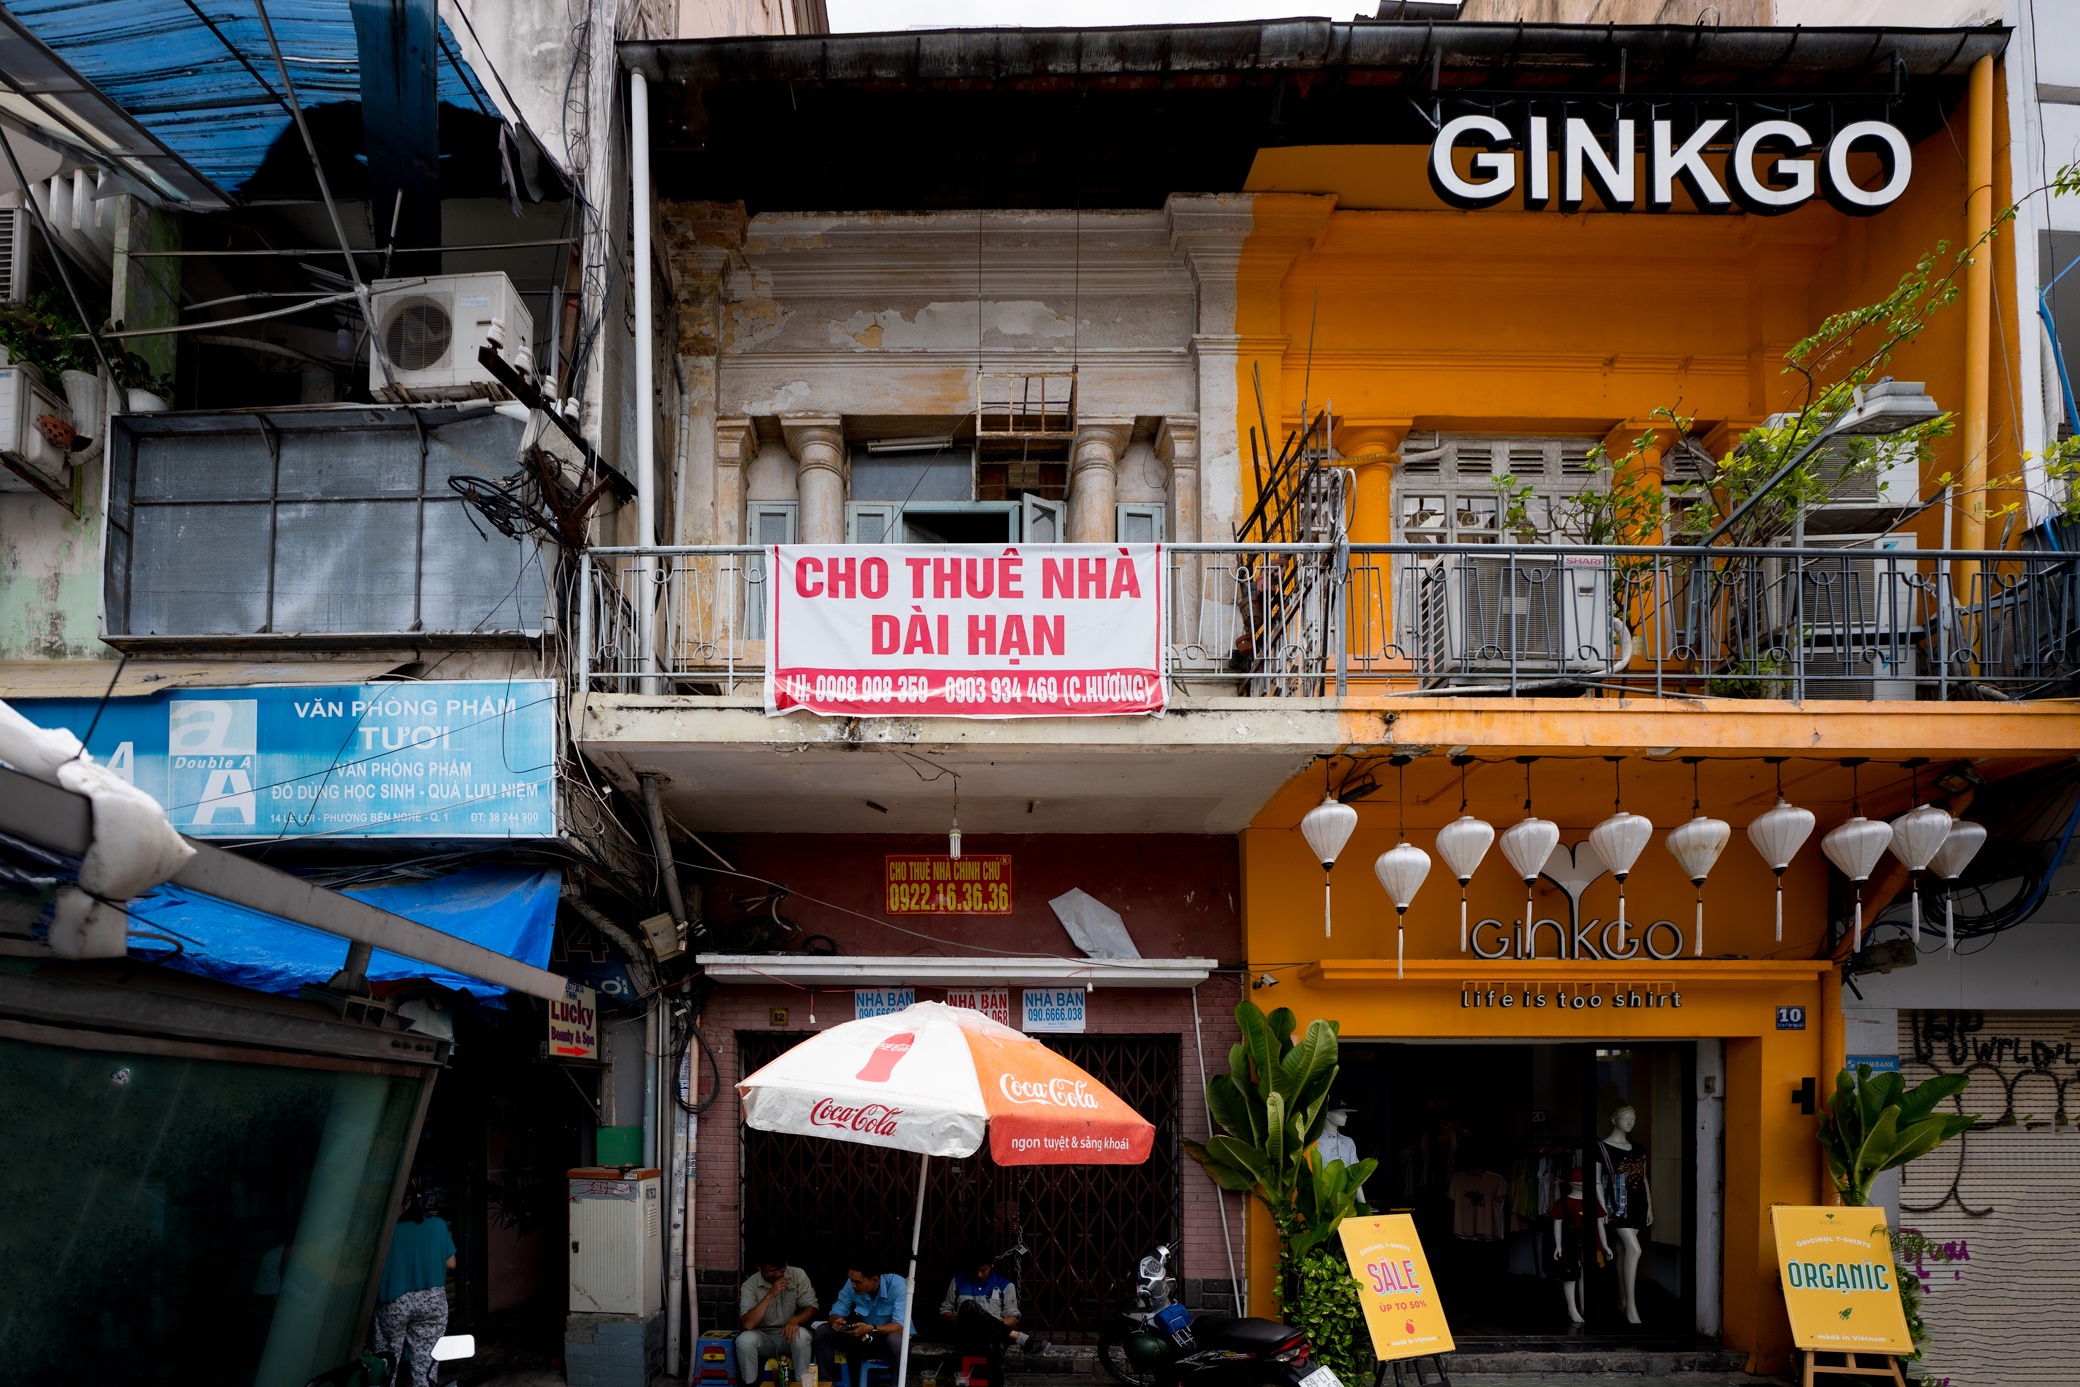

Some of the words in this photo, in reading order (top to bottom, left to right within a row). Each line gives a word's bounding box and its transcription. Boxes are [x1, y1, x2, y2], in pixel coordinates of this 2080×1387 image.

[1430, 114, 1913, 210] GINKGO
[1566, 557, 1605, 565] SHARP
[794, 556, 889, 600] CHO
[904, 547, 1025, 600] THUÊ
[1042, 547, 1142, 600] NHÀ
[871, 605, 949, 656] DÀI
[967, 613, 1065, 666] HẠN
[815, 674, 857, 703] 0908
[945, 676, 986, 703] 0903
[991, 676, 1024, 703] 934
[1027, 676, 1058, 703] 469
[294, 697, 343, 718] VĂN
[351, 696, 439, 717] PHÒNG
[447, 695, 517, 717] PHẨM
[358, 725, 451, 751] TƯƠI
[174, 756, 234, 769] Double
[240, 756, 251, 769] A
[336, 759, 368, 777] VĂN
[371, 759, 424, 777] PHÒNG
[298, 781, 339, 800] DÙNG
[344, 784, 376, 803] HỌC
[380, 783, 415, 800] SINH
[428, 780, 461, 800] QUÀ
[465, 782, 498, 799] LƯU
[501, 780, 539, 801] NIỆM
[270, 813, 280, 823] 14
[323, 811, 368, 823] PHƯỜNG
[489, 812, 500, 823] 38
[502, 812, 520, 823] 244
[521, 812, 539, 822] 900
[889, 860, 907, 881] CHO
[909, 857, 931, 880] THUÊ
[933, 857, 952, 880] NHÀ
[953, 857, 981, 880] CHÍNH
[889, 882, 1009, 911] 0922.16.36.36
[856, 989, 884, 1007] NHÀ
[888, 988, 914, 1006] BÁN
[949, 990, 976, 1009] NHÀ
[981, 990, 1008, 1009] BÁN
[1025, 989, 1053, 1007] NHÀ
[1056, 988, 1084, 1007] BÁN
[1461, 990, 1514, 1008] life
[1522, 990, 1547, 1008] is
[1556, 991, 1603, 1009] too
[1612, 990, 1682, 1008] shirt
[551, 999, 595, 1031] Lucky
[774, 1012, 785, 1022] 12
[1028, 1007, 1083, 1021] 090.6666.038
[1779, 1008, 1802, 1023] 10
[551, 1026, 574, 1045] Beauty
[575, 1030, 581, 1044] &
[582, 1031, 595, 1048] Spa
[999, 1073, 1099, 1109] Coca-Cola
[810, 1097, 905, 1137] Coca-Cola
[1011, 1137, 1040, 1152] ngon
[1043, 1136, 1069, 1151] tuyệt
[1071, 1136, 1078, 1148] &
[1080, 1136, 1102, 1151] sảng
[1104, 1137, 1129, 1150] khoái
[1409, 1300, 1428, 1309] 50%
